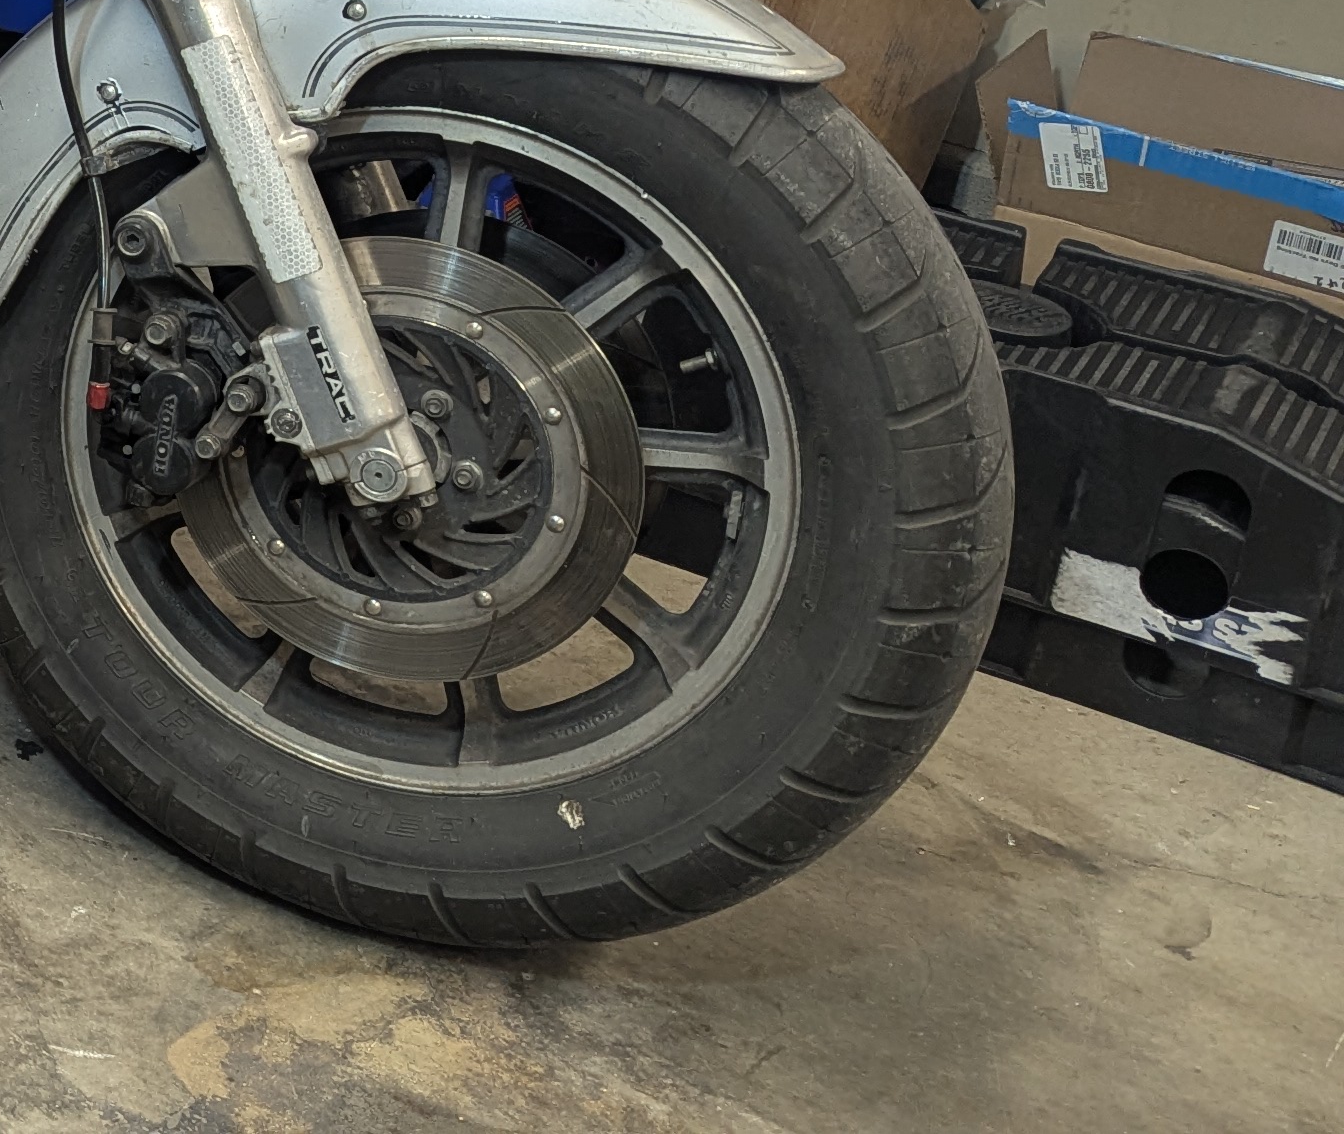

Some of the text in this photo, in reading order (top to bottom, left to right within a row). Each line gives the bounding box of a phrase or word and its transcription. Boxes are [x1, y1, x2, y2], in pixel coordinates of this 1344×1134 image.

[306, 326, 356, 424] TRAC
[153, 395, 178, 476] HONDA
[82, 623, 464, 844] TOUR MASTER
